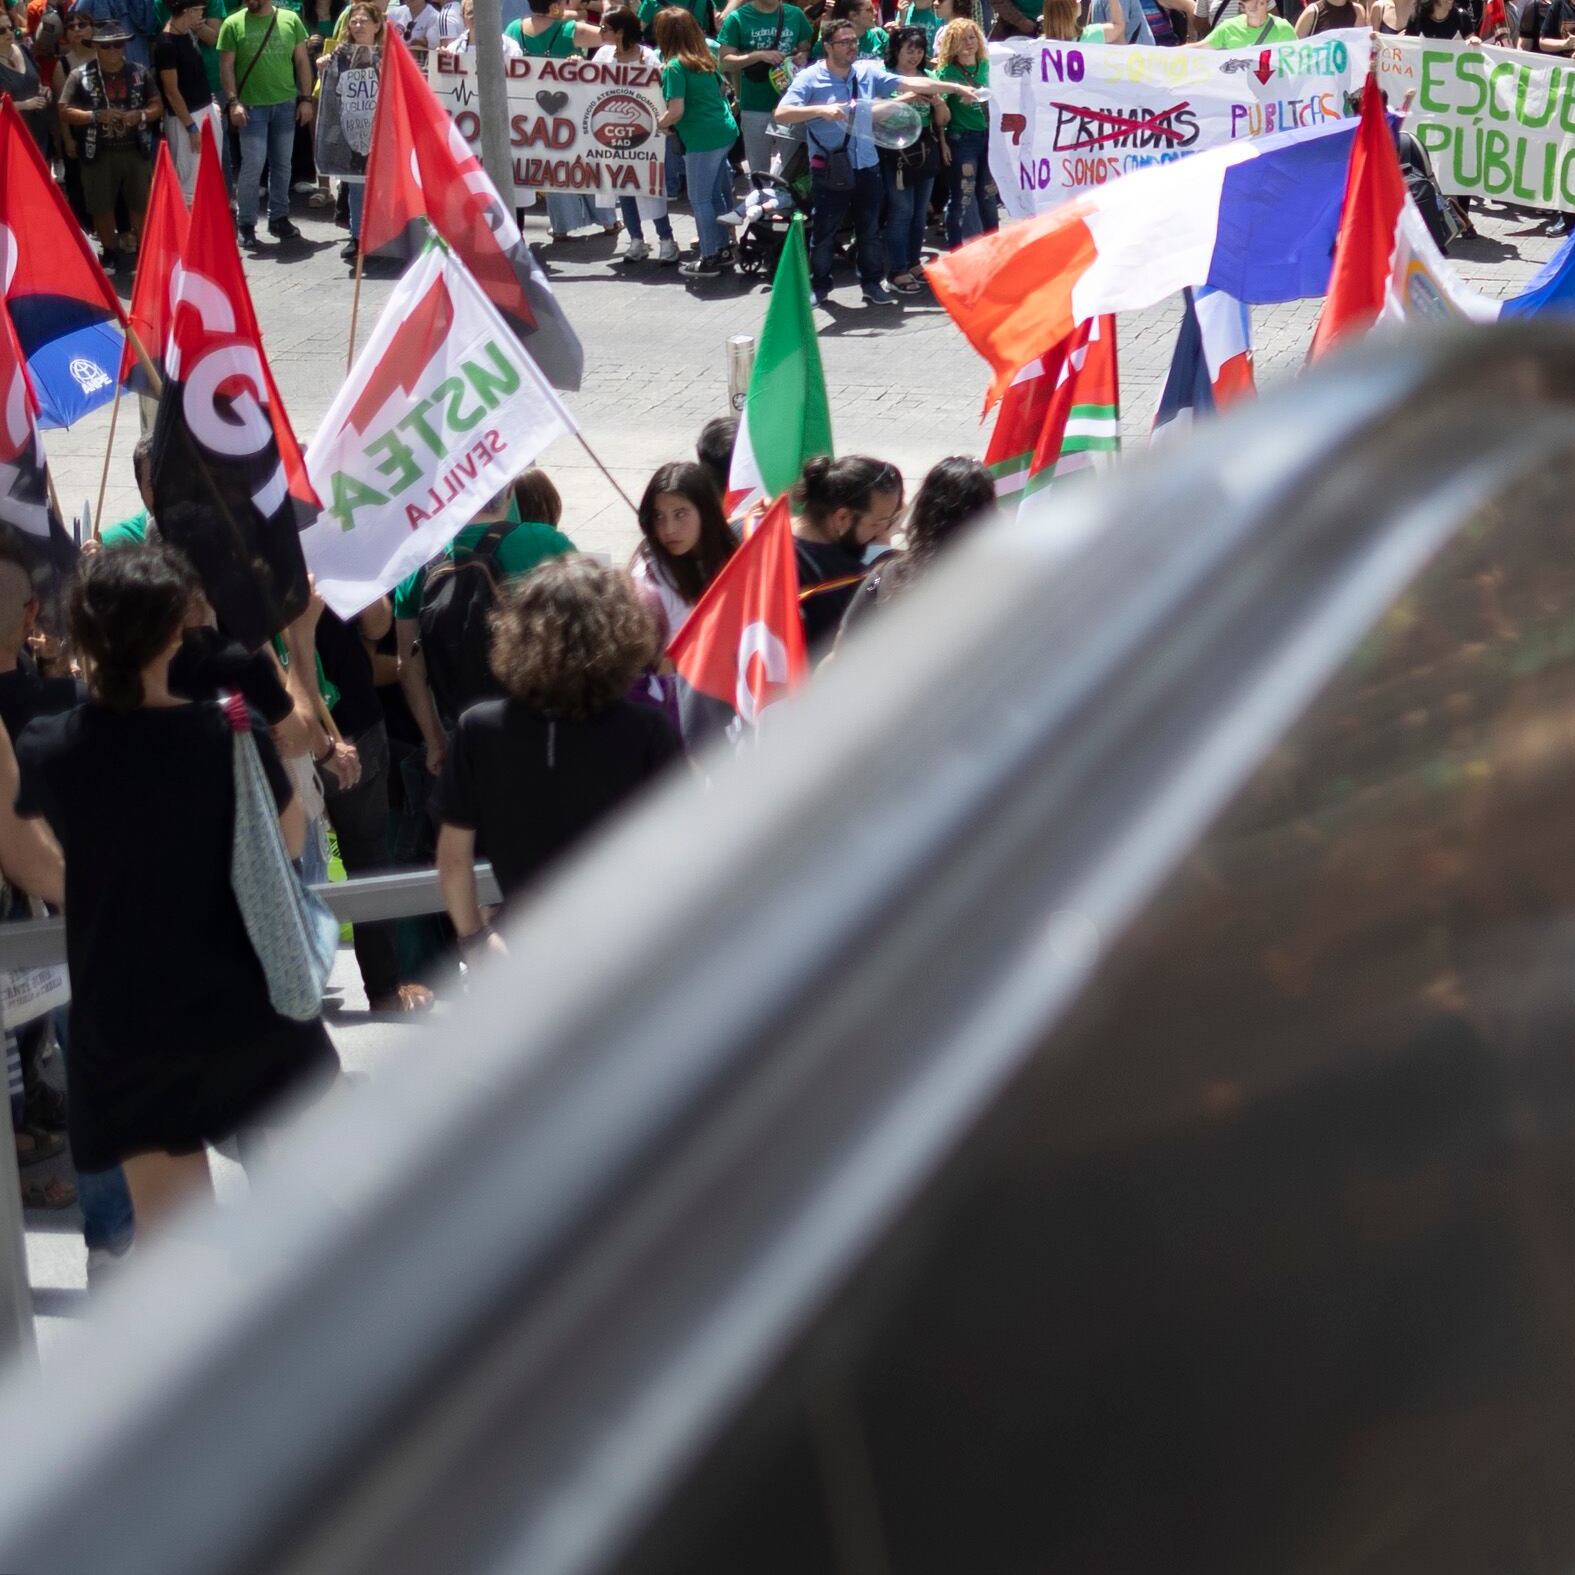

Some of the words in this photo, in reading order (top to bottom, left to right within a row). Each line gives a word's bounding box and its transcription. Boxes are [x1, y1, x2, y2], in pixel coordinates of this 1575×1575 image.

[437, 54, 468, 75] EL
[1041, 48, 1085, 83] NO
[1103, 47, 1213, 84] SOMOS
[1278, 39, 1348, 78] RATIO
[347, 71, 366, 80] POR
[538, 59, 662, 87] AGONIZA
[1381, 62, 1414, 78] UNA
[347, 80, 379, 99] SAD
[583, 99, 597, 135] SERVICIO
[597, 88, 635, 102] ATENCIÓN
[511, 115, 577, 149] SAD
[604, 125, 636, 138] CGT
[611, 138, 631, 147] SAD
[586, 149, 658, 161] ANDALUCIA
[606, 165, 641, 189] YA
[1020, 158, 1051, 191] NO
[1062, 157, 1122, 187] SOMOS
